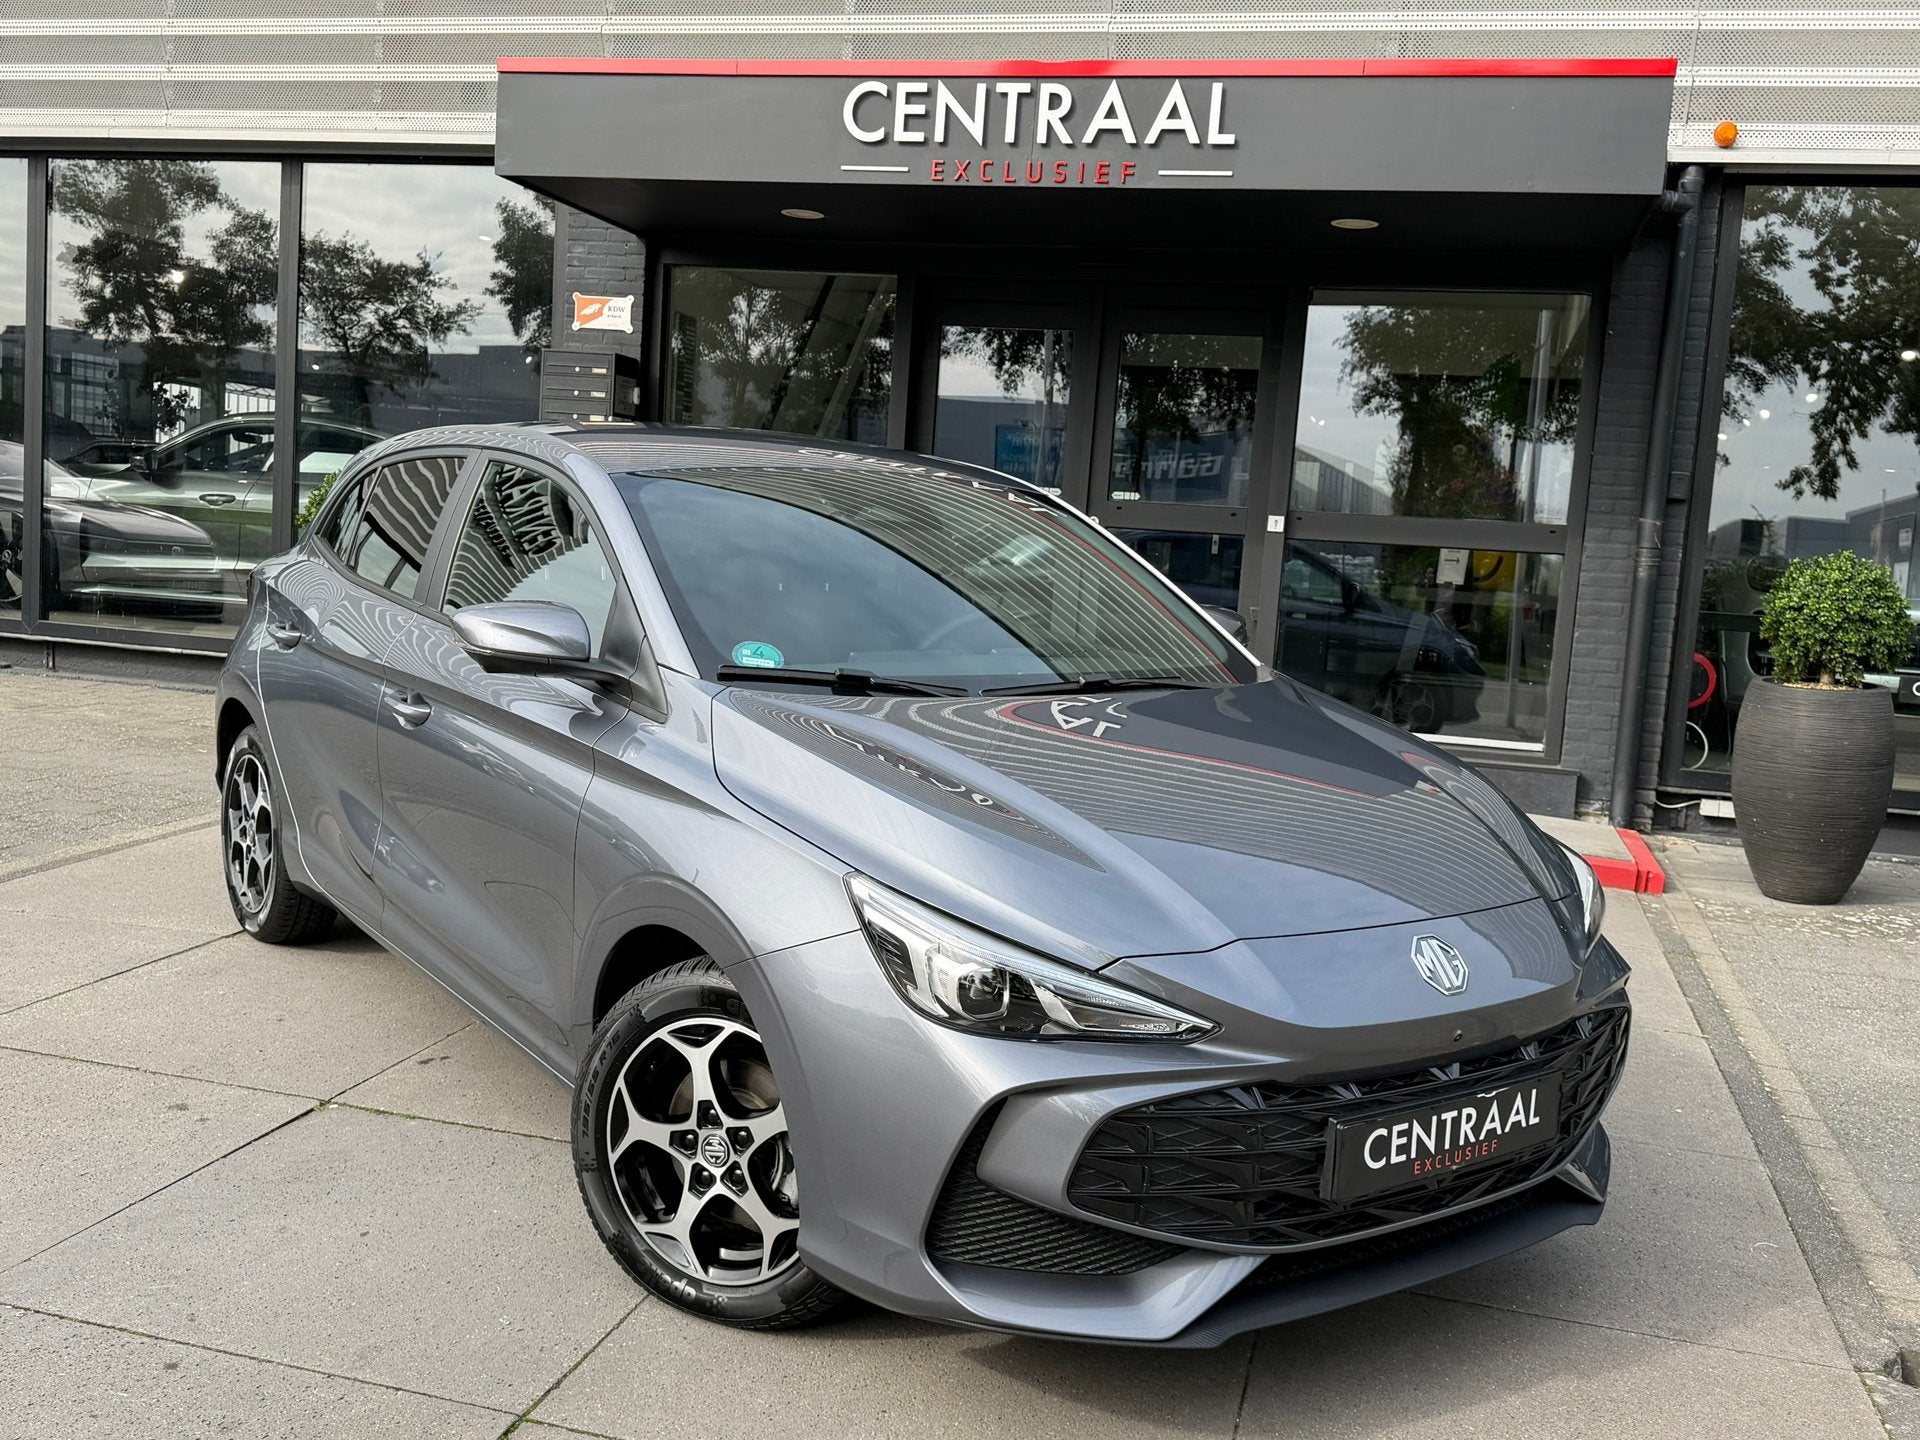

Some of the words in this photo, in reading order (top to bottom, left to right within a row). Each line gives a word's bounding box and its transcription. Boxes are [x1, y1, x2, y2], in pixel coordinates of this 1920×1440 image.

[842, 78, 1237, 146] CENTRAAL
[930, 158, 1137, 184] EXCLUSIEF
[607, 305, 626, 313] RDW
[752, 645, 766, 659] 4
[1413, 936, 1466, 991] MG
[1364, 1088, 1540, 1170] CENTRAAL
[704, 1138, 726, 1164] MG
[1414, 1139, 1498, 1175] EXCLUSIEF
